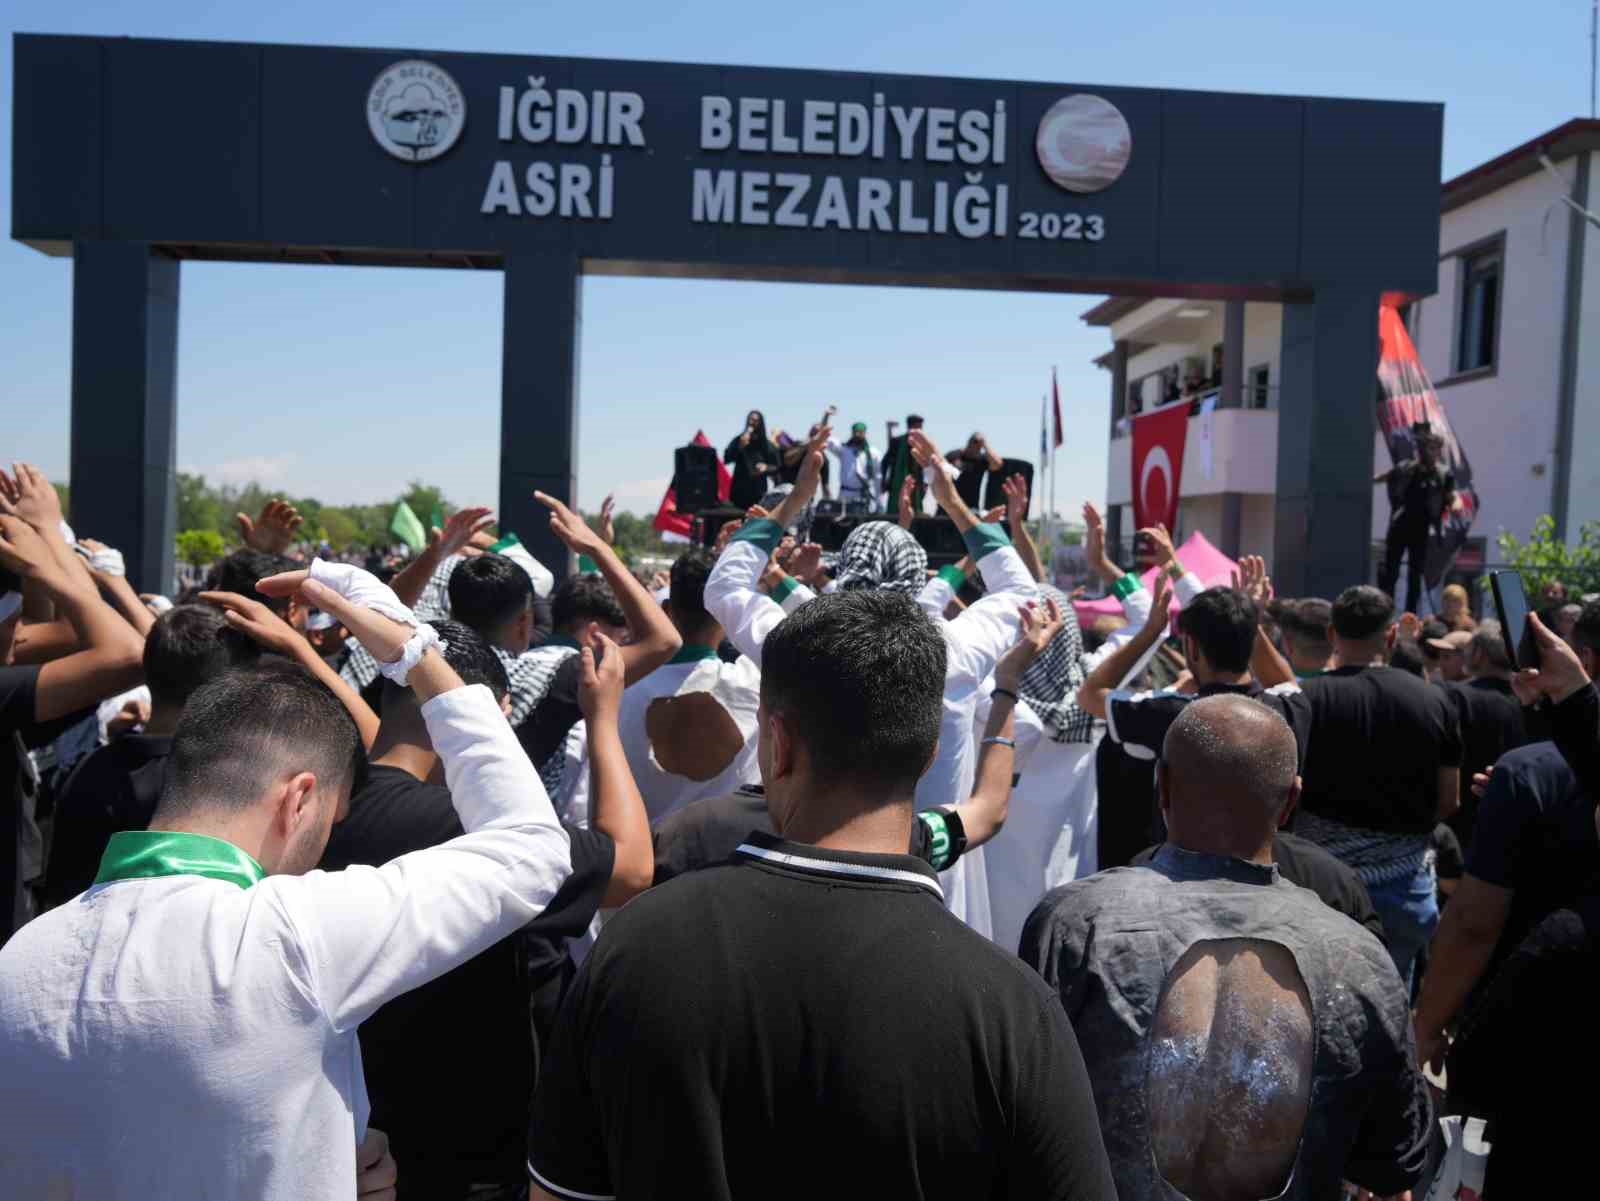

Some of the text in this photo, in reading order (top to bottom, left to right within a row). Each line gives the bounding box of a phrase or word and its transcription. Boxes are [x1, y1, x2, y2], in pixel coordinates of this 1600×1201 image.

[498, 75, 1006, 164] IĞDIR BELEDİYESİ
[480, 153, 1105, 241] ASRİ MEZARLIĞI 2023
